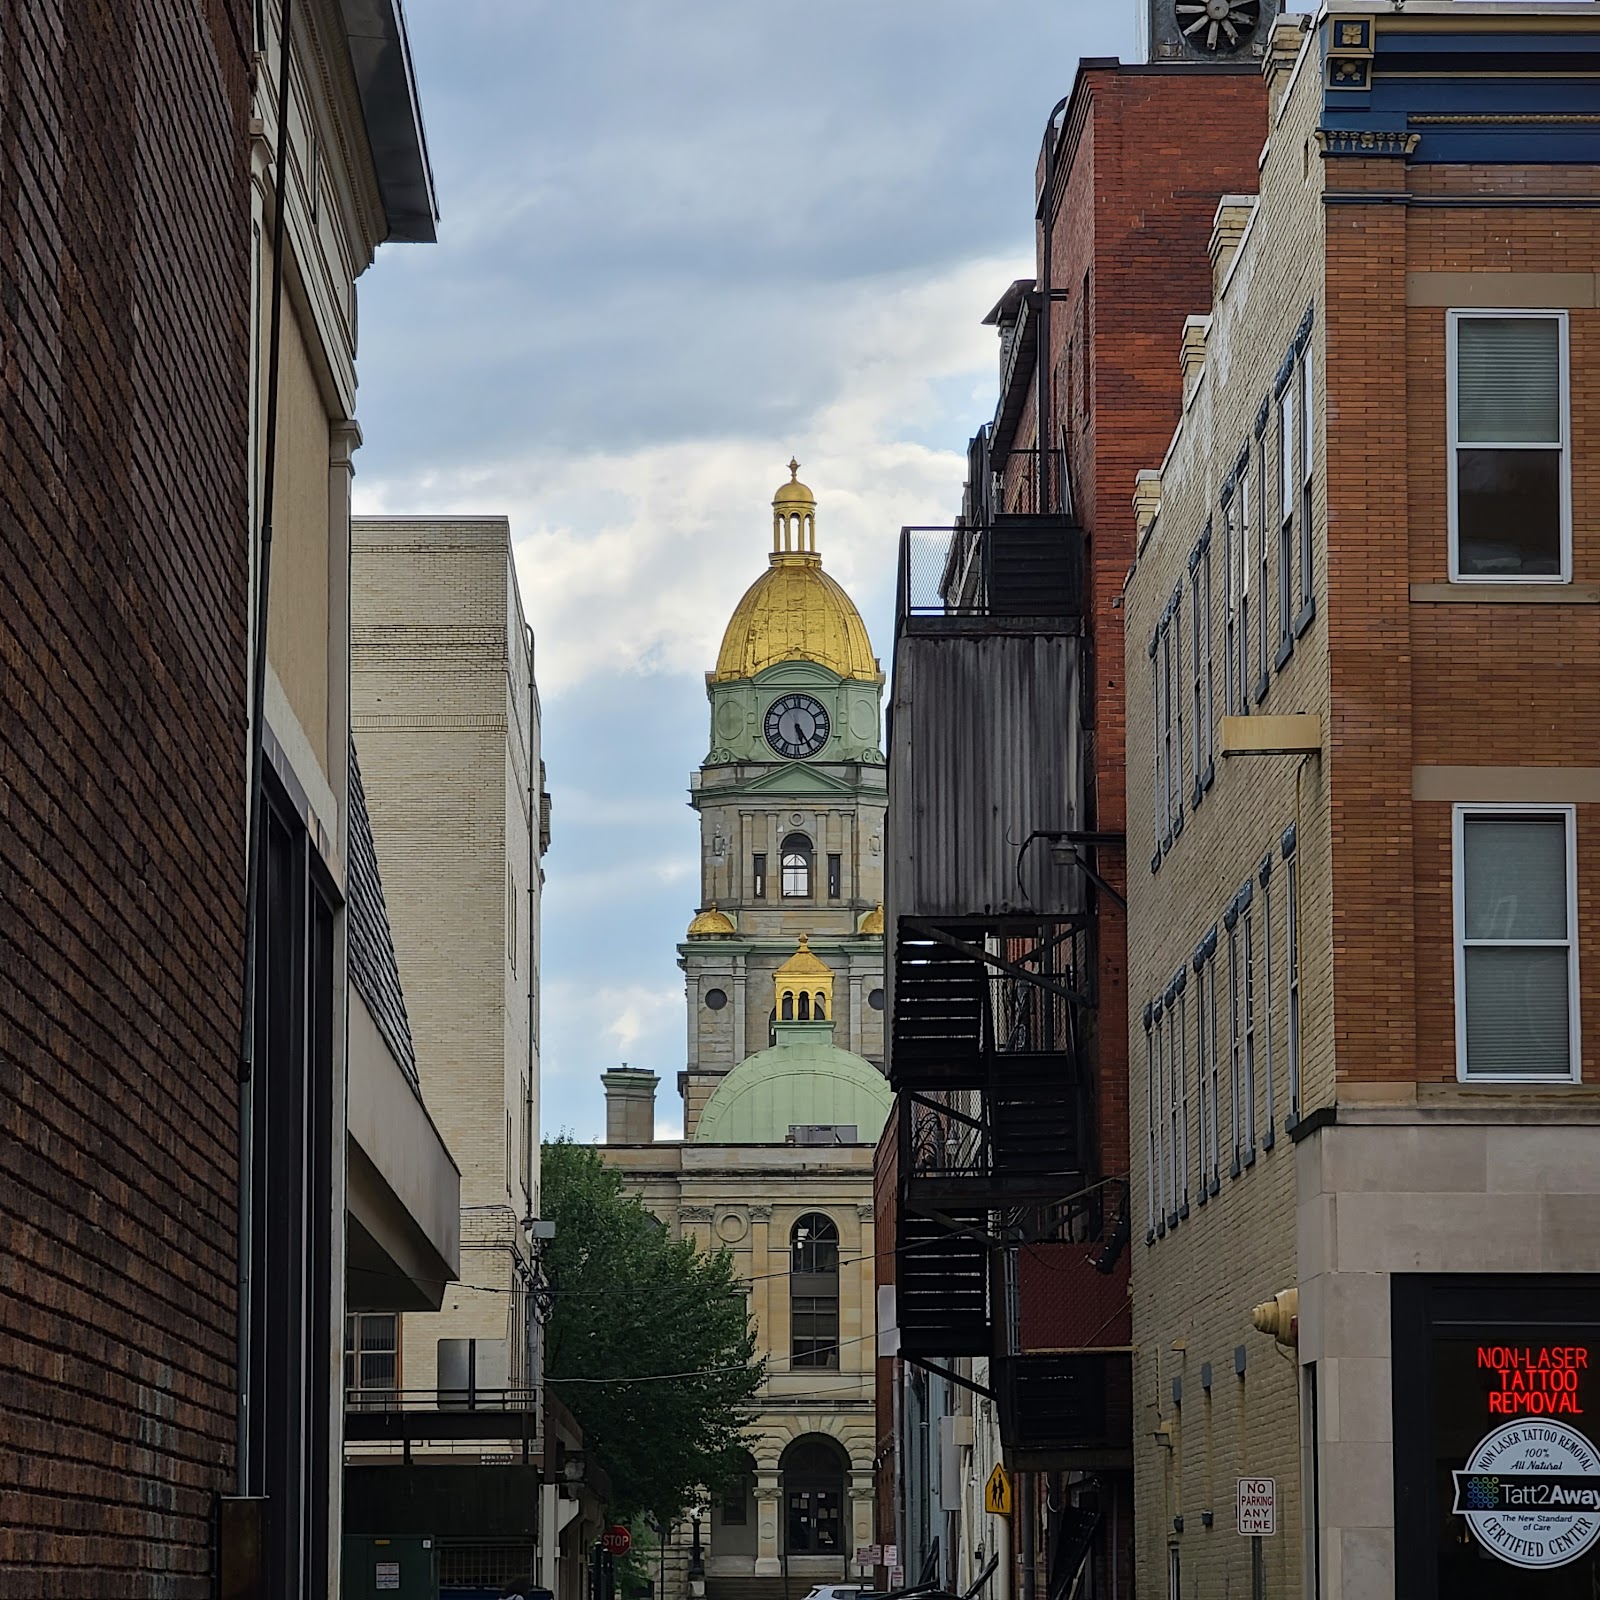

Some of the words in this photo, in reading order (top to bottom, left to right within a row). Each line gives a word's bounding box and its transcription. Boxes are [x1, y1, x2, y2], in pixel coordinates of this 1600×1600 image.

[1478, 1346, 1588, 1369] NON-LASER
[1498, 1369, 1578, 1392] TATTOO
[1489, 1392, 1584, 1414] REMOVAL
[1478, 1450, 1495, 1472] NON
[1492, 1432, 1522, 1456] LASER
[1522, 1428, 1558, 1442] TATTOO
[1558, 1435, 1594, 1472] REMOVAL
[1524, 1448, 1550, 1458] 100%
[1510, 1460, 1524, 1470] All
[1526, 1460, 1563, 1470] Natural
[1248, 1484, 1266, 1494] NO
[1242, 1496, 1272, 1506] PARKING
[1244, 1508, 1269, 1517] ANY
[1242, 1520, 1270, 1529] TIME
[602, 1534, 629, 1546] STOP
[1482, 1517, 1544, 1557] CERTIFIED
[1548, 1516, 1594, 1556] CENTER
